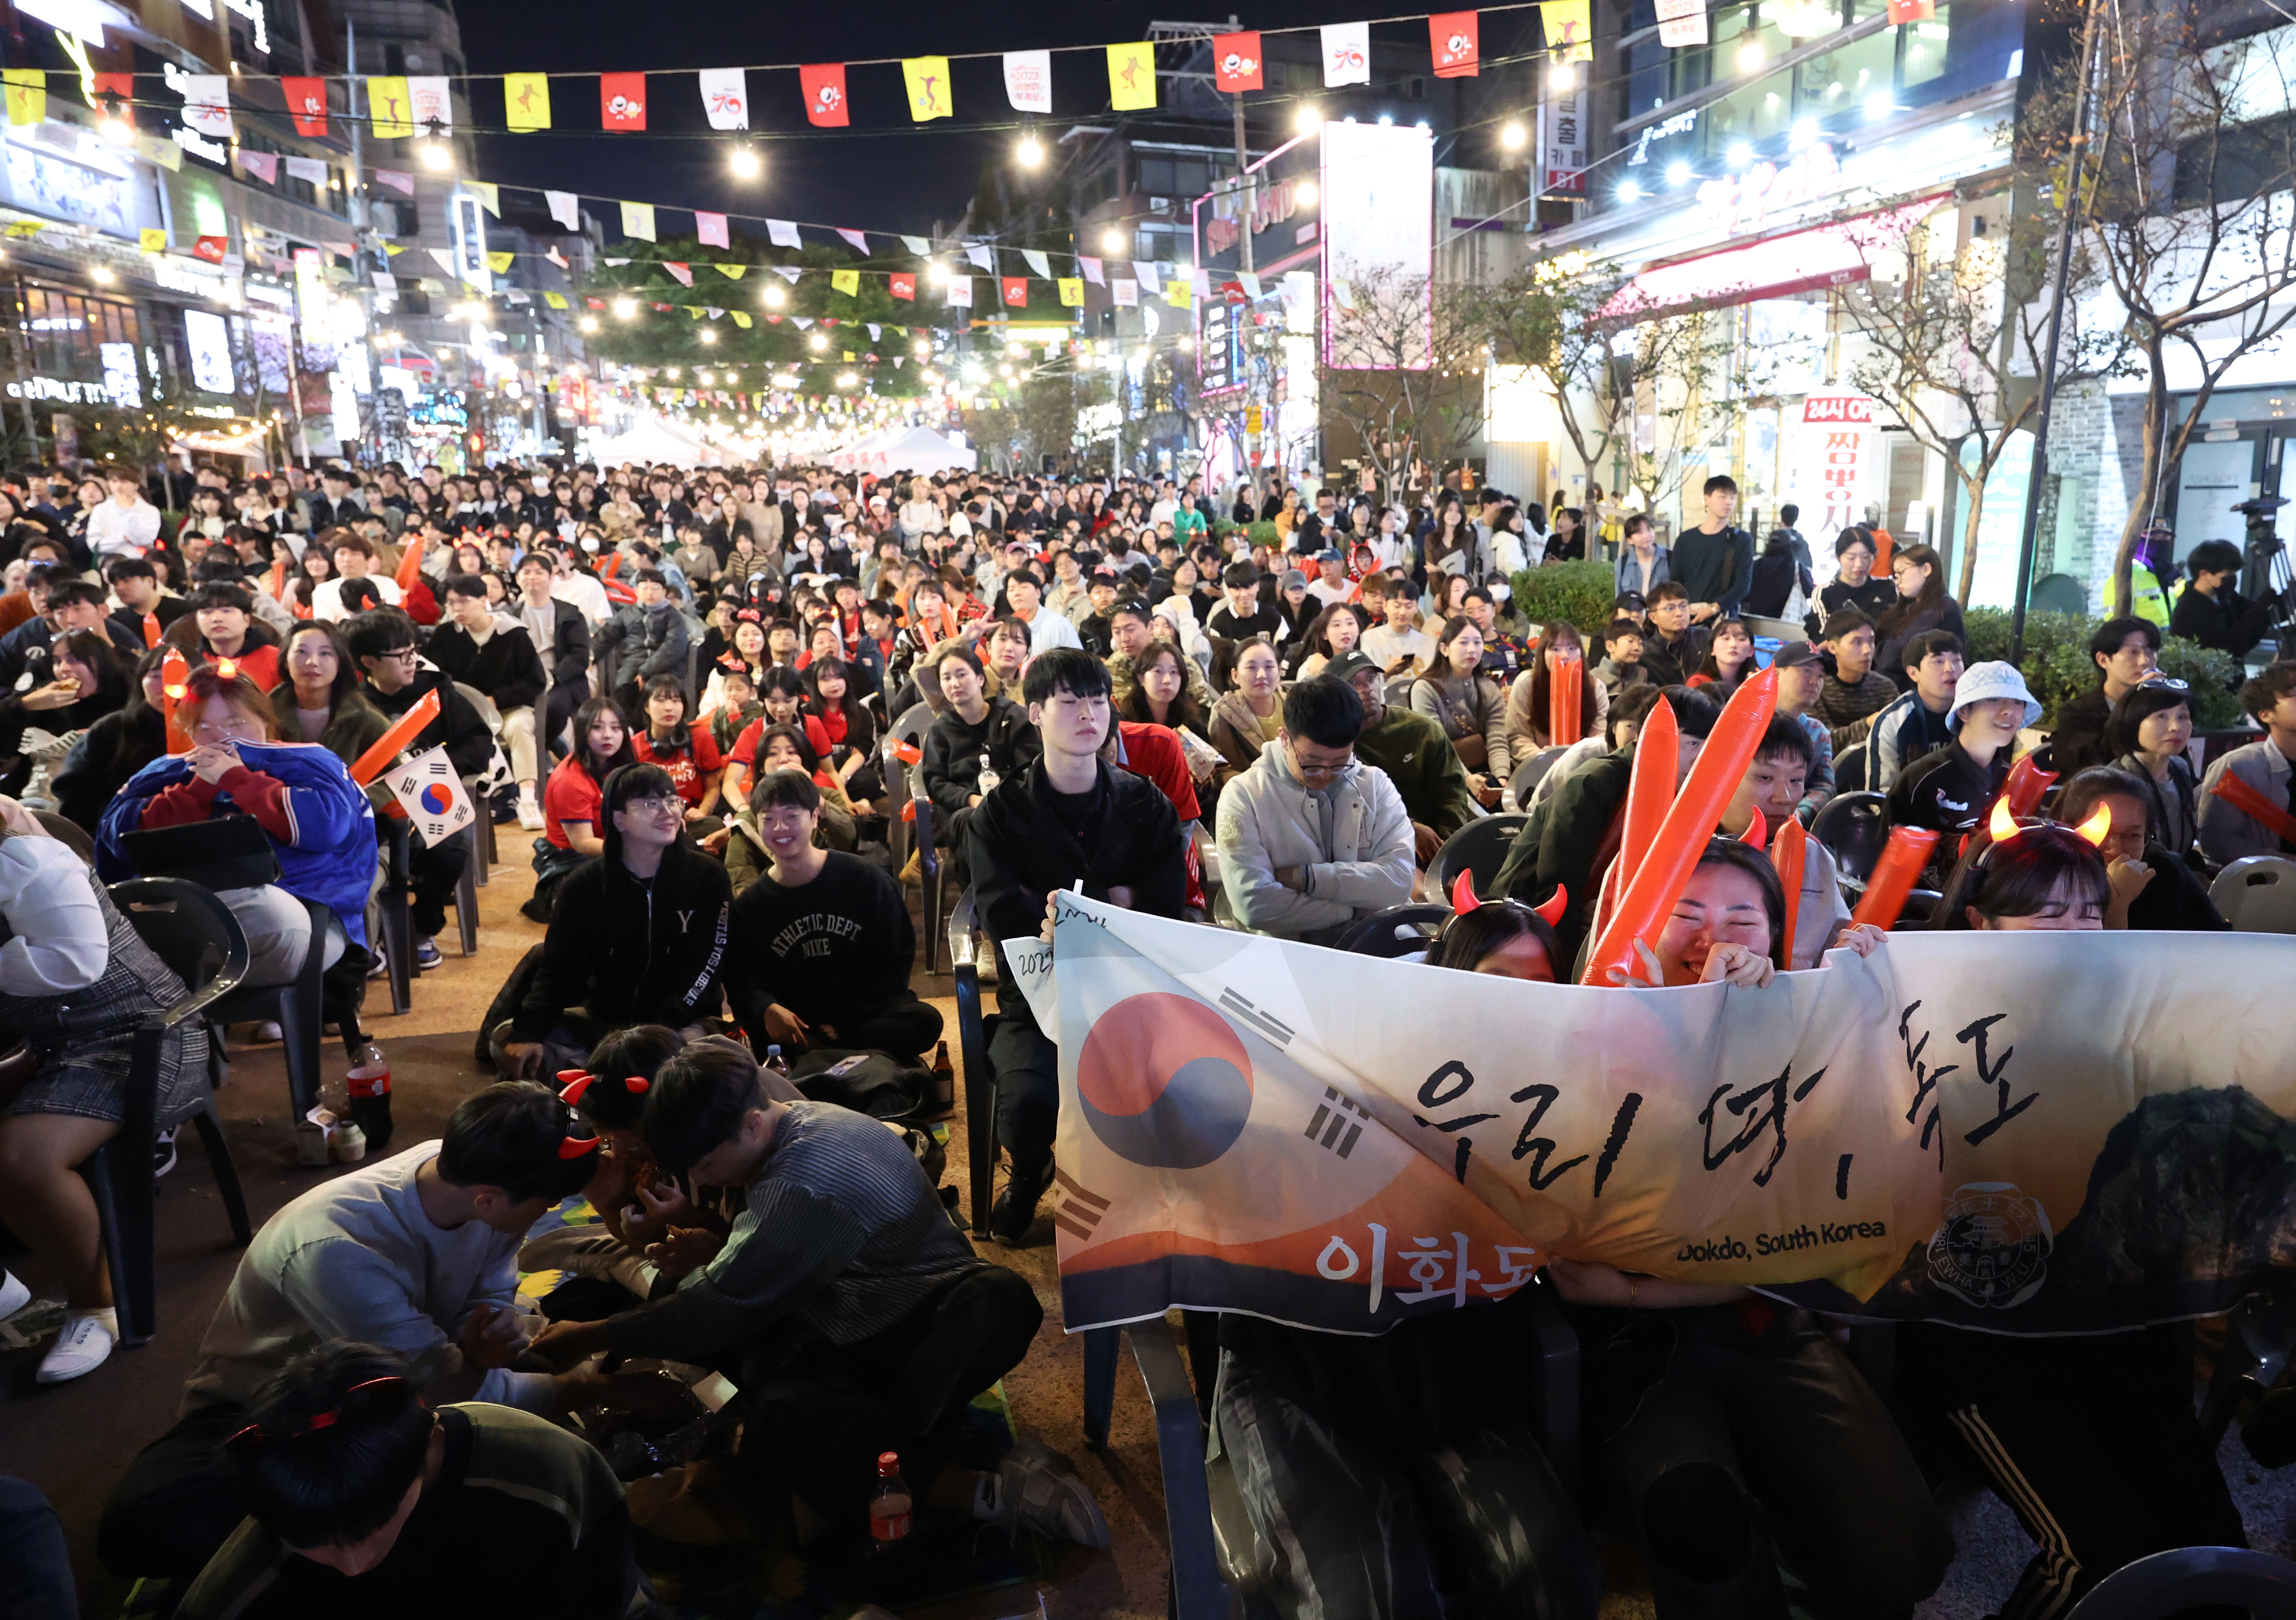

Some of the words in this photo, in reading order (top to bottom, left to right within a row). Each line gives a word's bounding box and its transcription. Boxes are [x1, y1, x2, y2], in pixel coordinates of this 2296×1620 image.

[1808, 399, 1845, 420] 24시
[677, 910, 696, 934] Y
[770, 914, 824, 958] ATHLETIC
[802, 938, 831, 959] NIKE
[1413, 1059, 1643, 1198] 우리
[1755, 1224, 1819, 1256] South
[1821, 1221, 1886, 1245] Korea
[1937, 1256, 1973, 1290] EWHA
